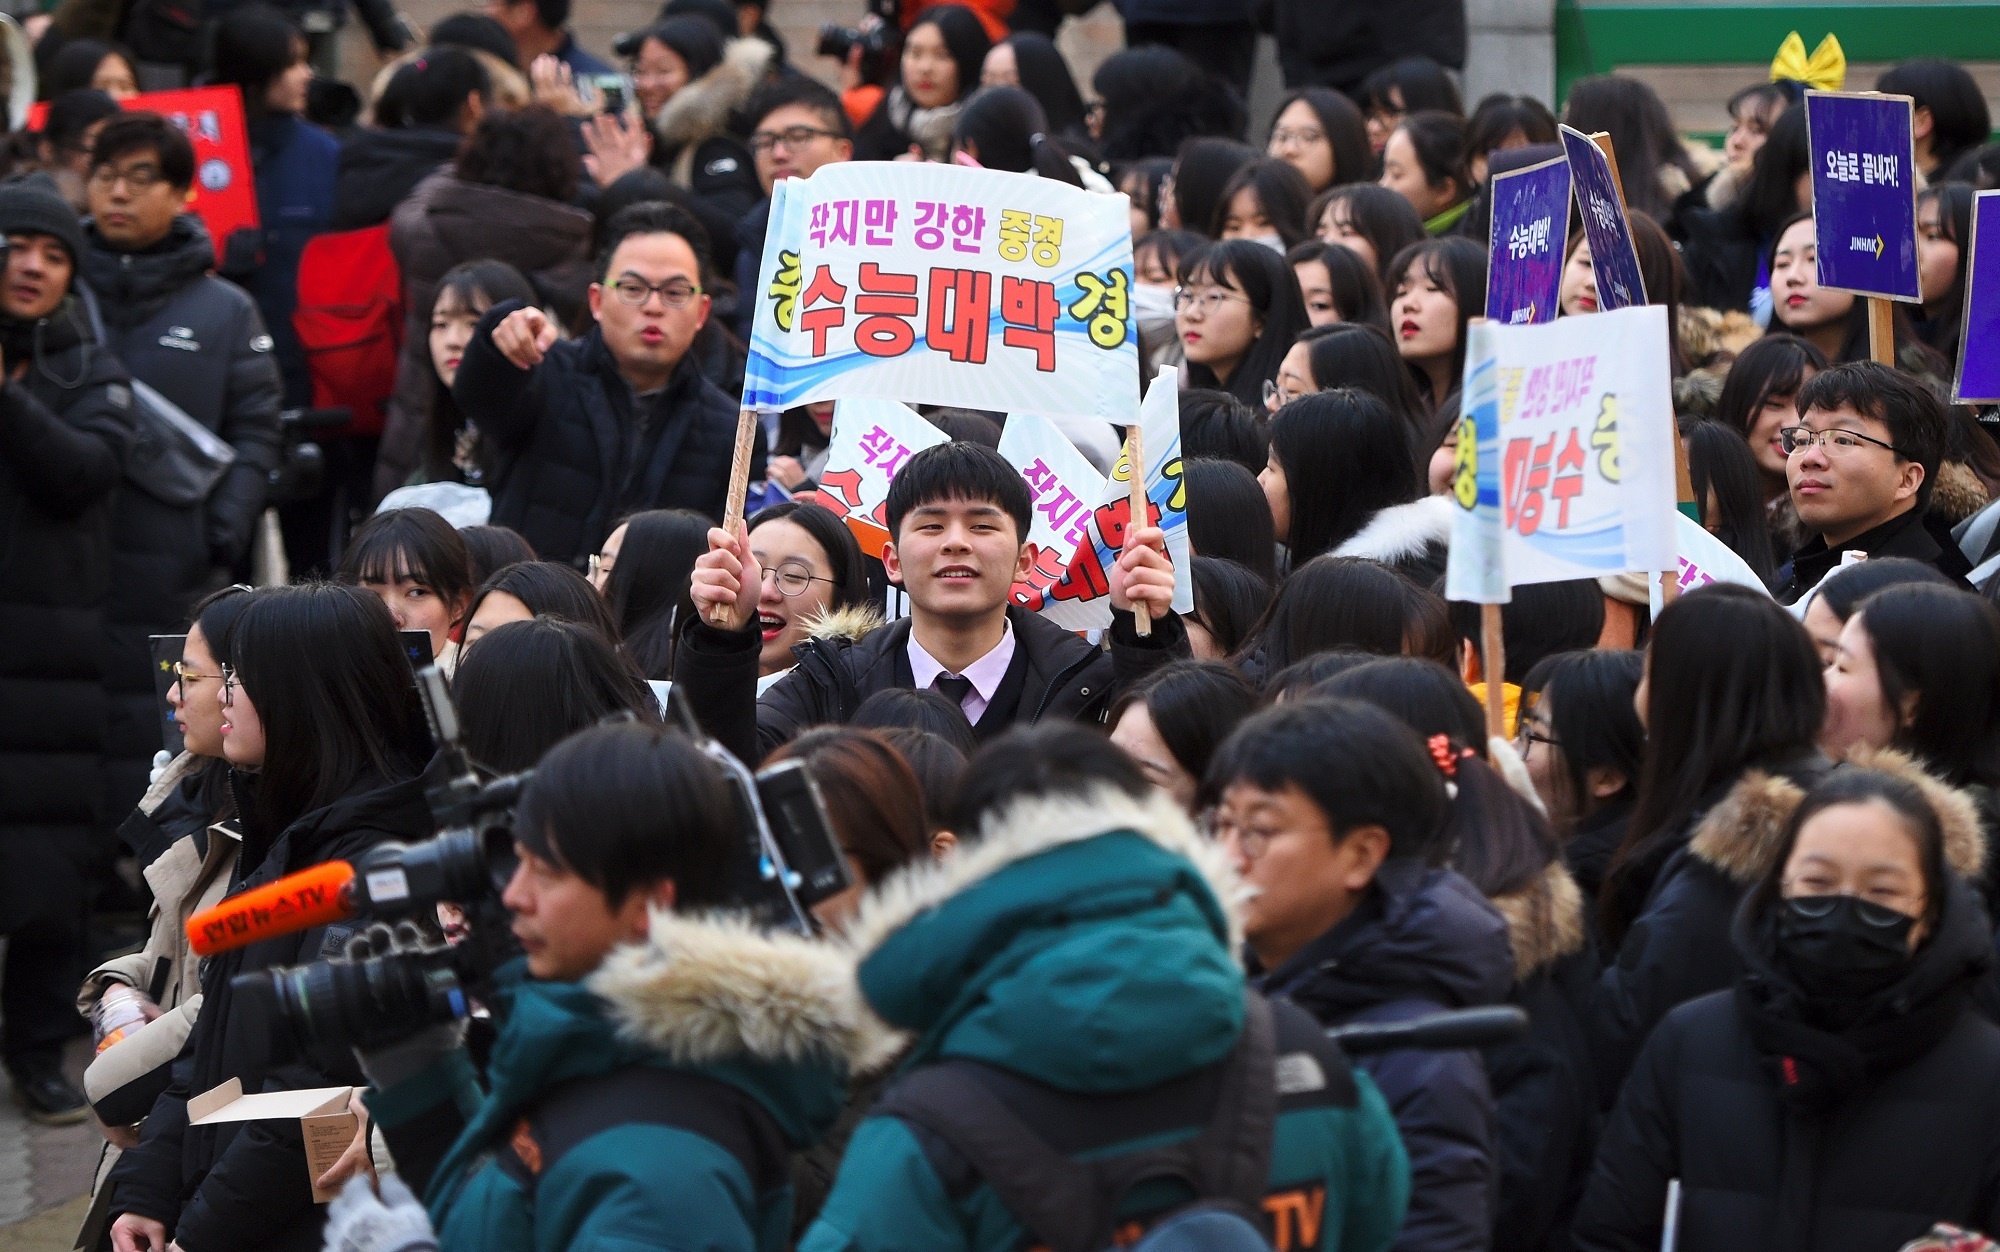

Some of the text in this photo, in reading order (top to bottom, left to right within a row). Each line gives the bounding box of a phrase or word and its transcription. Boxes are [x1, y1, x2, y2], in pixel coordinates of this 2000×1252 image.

[1826, 150, 1899, 188] 오늘로 끝내자!
[809, 199, 1064, 268] 작지만 강한 중경
[1509, 216, 1551, 260] 수능대박!
[1849, 236, 1877, 253] JINHAK
[800, 262, 1060, 372] 수능대박
[1068, 267, 1130, 350] 경
[1261, 1186, 1326, 1252] TV
